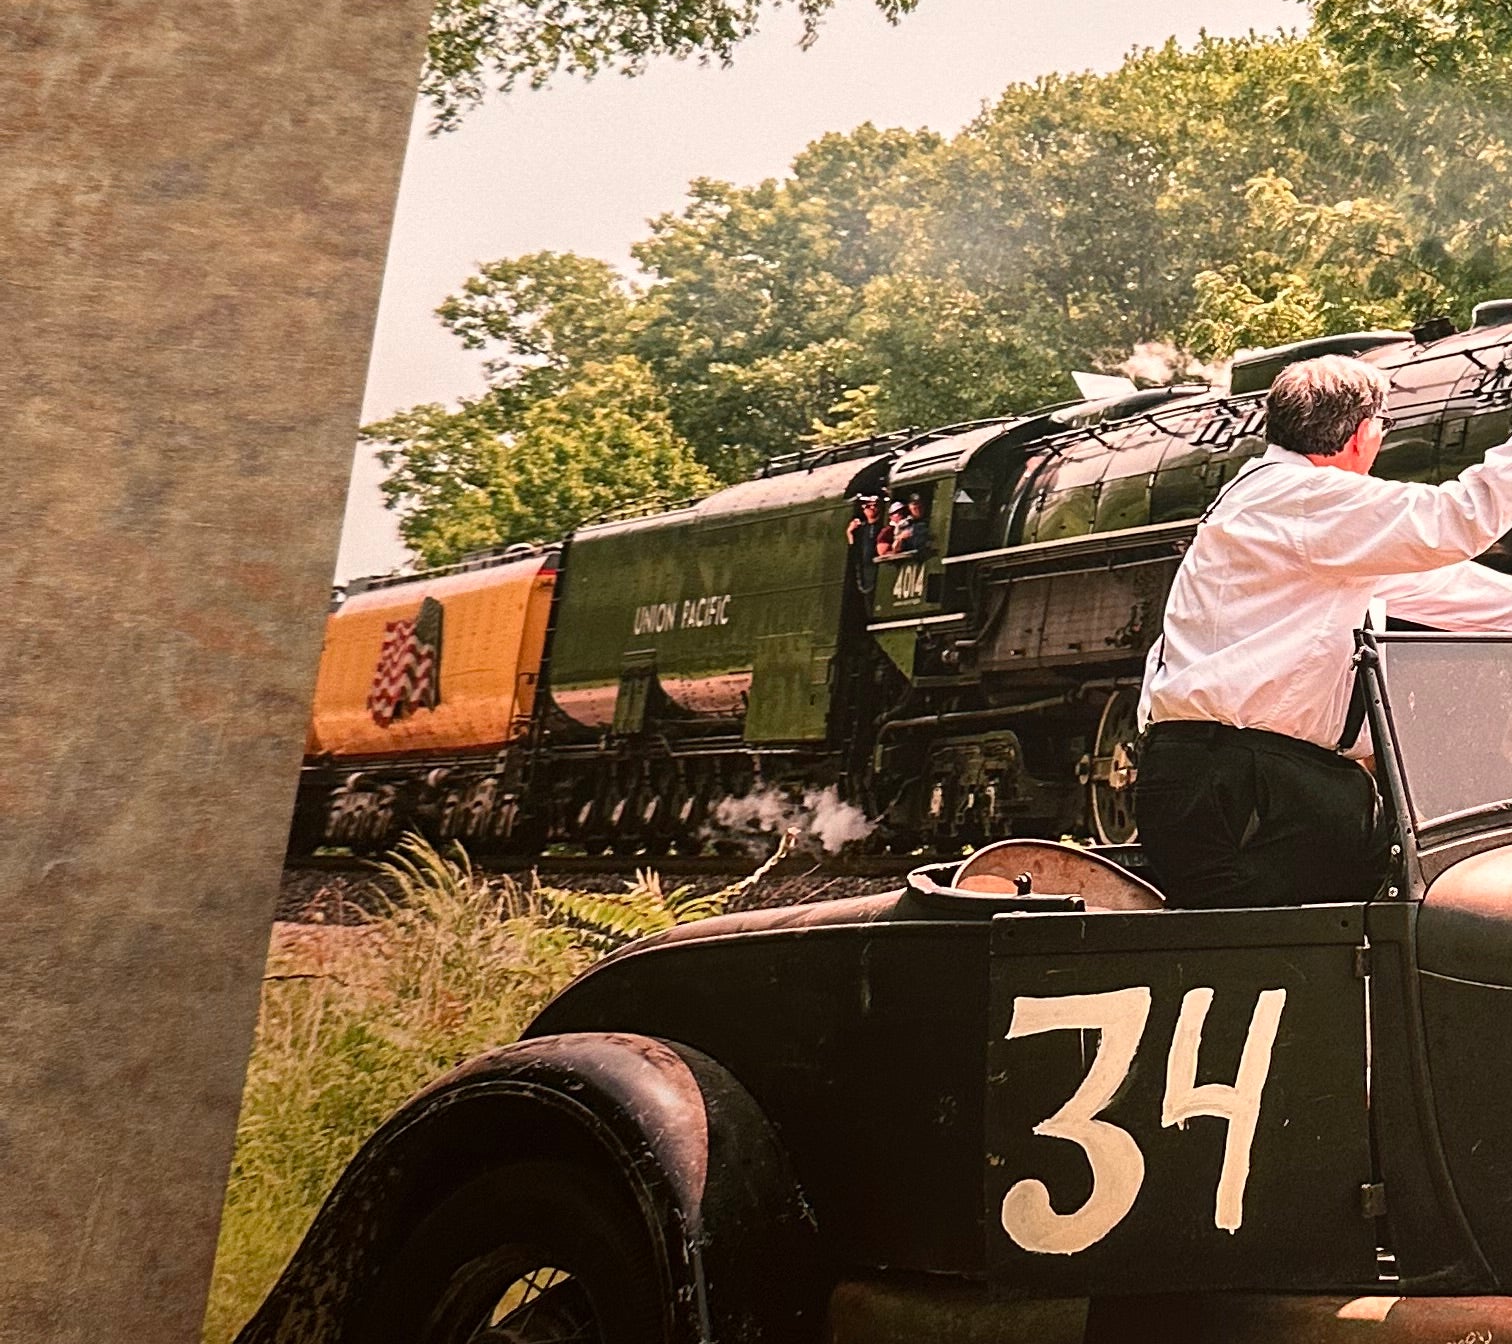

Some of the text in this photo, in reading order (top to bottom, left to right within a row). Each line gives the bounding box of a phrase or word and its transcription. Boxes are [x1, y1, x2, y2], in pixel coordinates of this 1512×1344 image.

[893, 564, 925, 599] 4014
[633, 594, 732, 636] UNION PACIFIC
[1001, 986, 1288, 1256] 34
